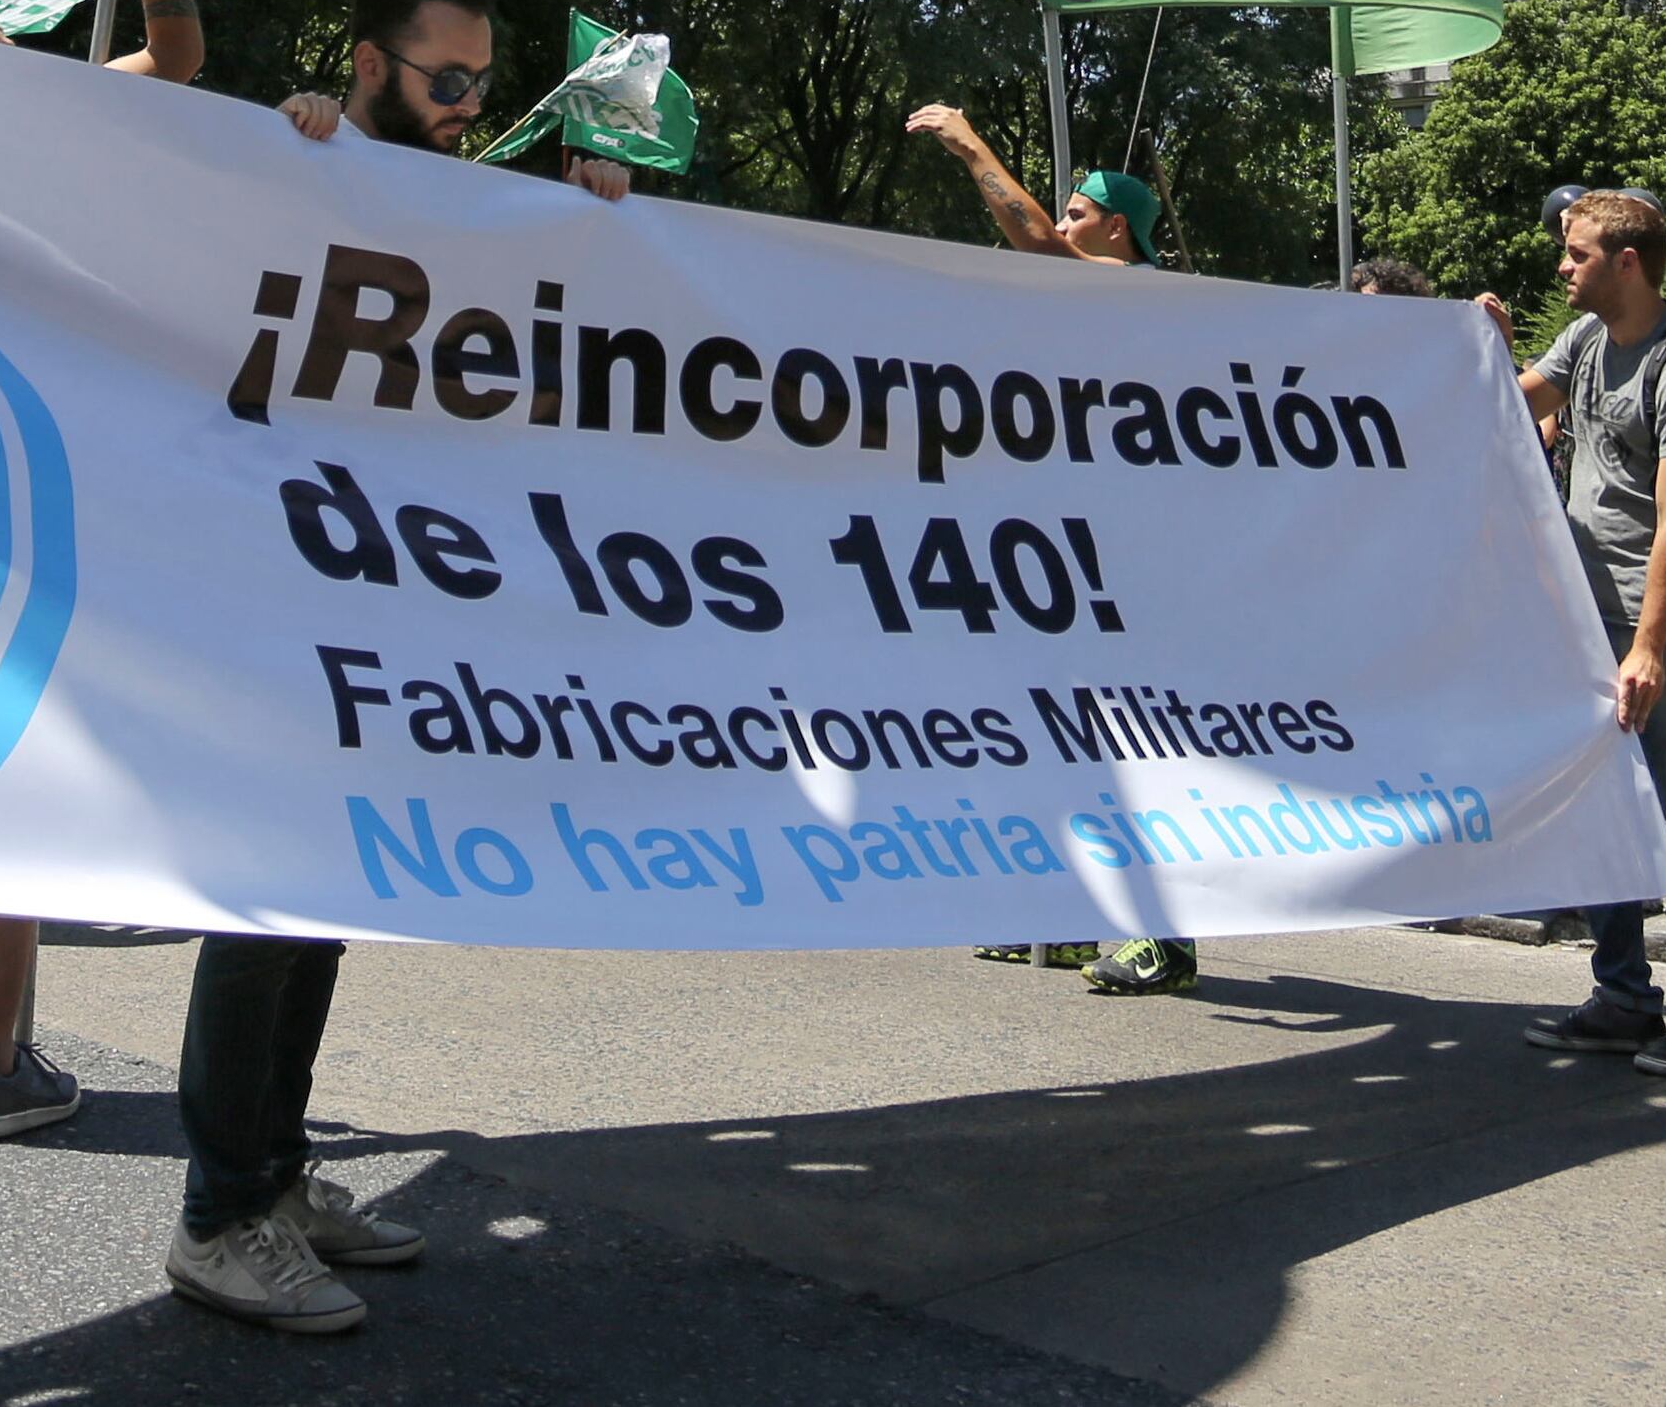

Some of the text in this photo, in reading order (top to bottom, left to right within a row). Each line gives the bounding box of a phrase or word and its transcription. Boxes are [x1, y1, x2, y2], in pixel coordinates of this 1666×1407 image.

[226, 243, 1408, 484] ¡Reincorporación
[278, 459, 1127, 635] de los 140!
[314, 643, 1355, 772] Fabricaciones Militares
[345, 771, 1493, 907] No hay patria sin industria
